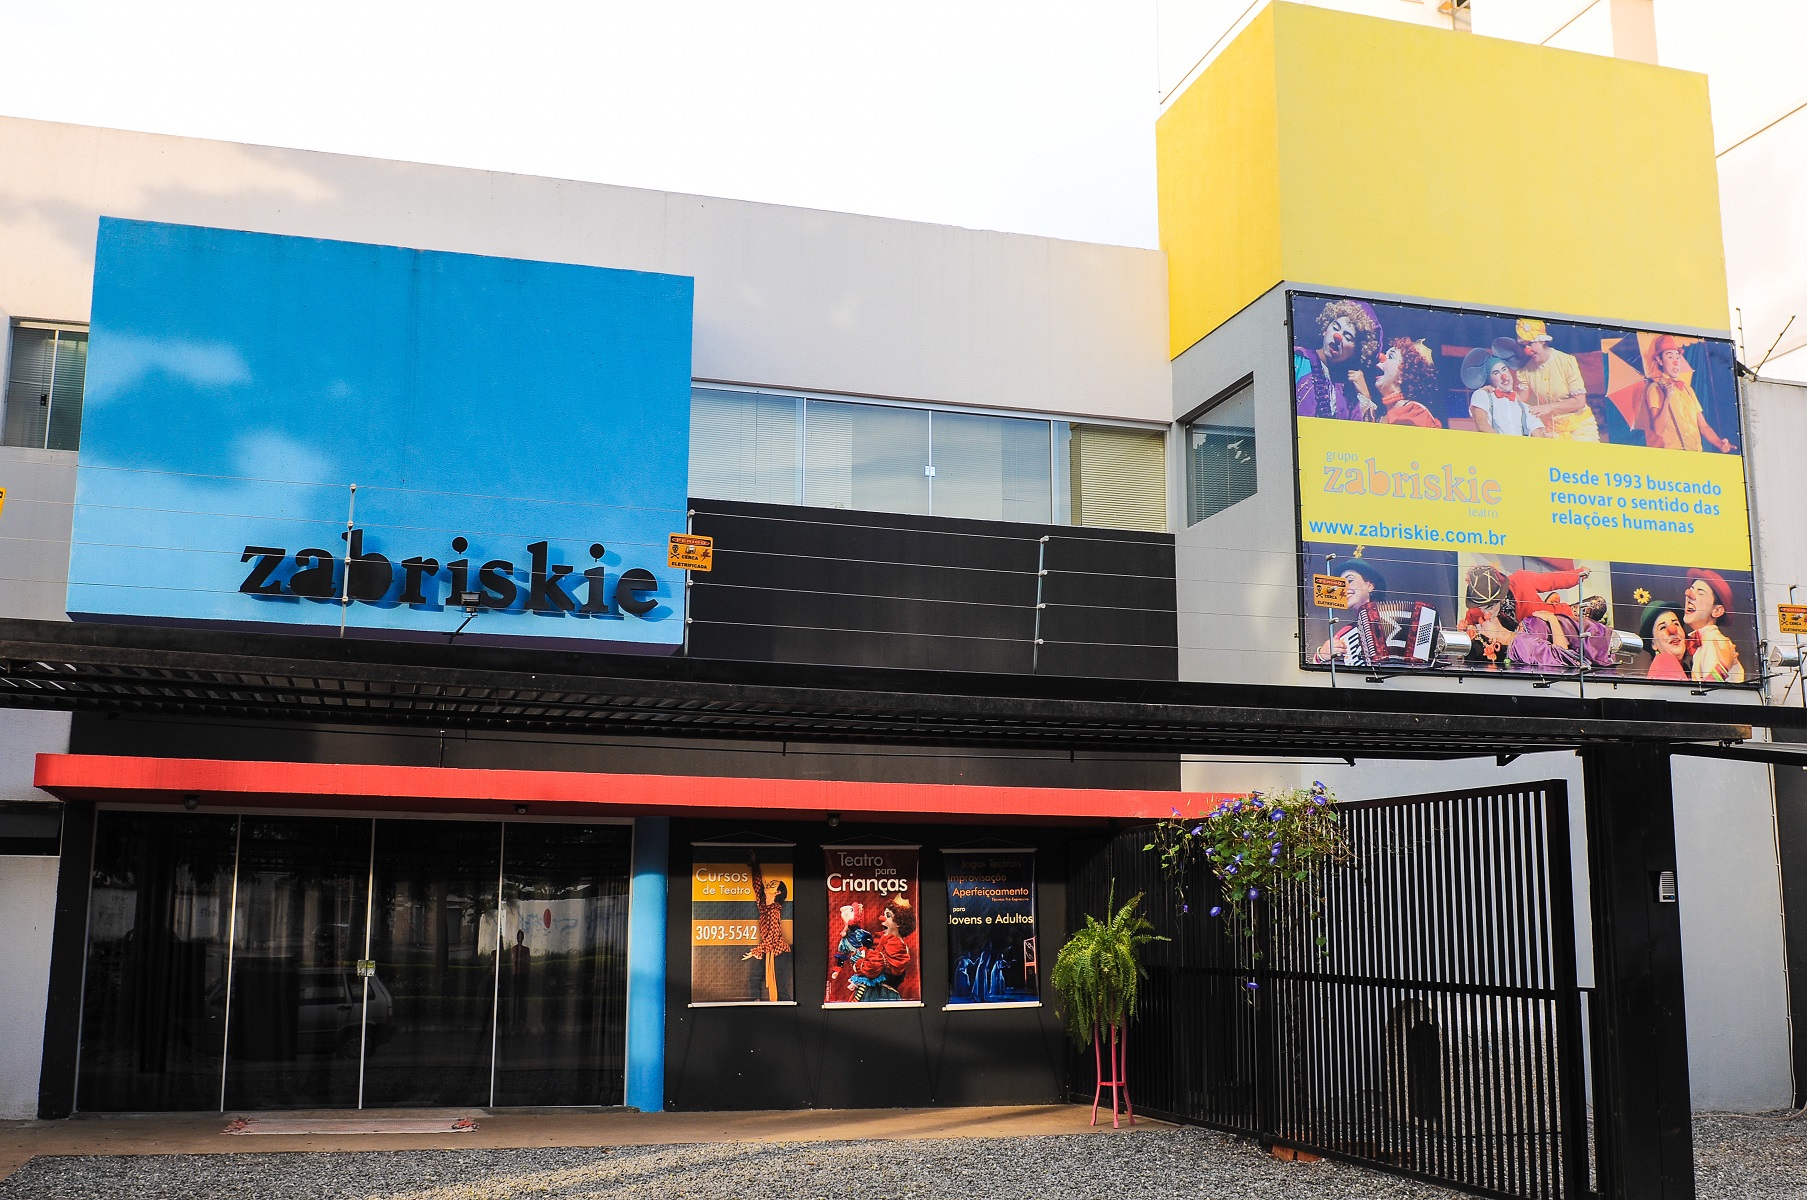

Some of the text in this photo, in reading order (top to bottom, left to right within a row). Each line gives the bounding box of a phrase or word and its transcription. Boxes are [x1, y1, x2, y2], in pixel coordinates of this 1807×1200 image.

[1326, 450, 1359, 463] grupo
[1323, 457, 1502, 505] zabriskie
[1549, 467, 1722, 496] Desde 1993 buscando
[1551, 491, 1720, 516] renovar o sentido das
[1468, 507, 1499, 518] teatro
[1552, 509, 1695, 534] relações humanas
[1309, 520, 1507, 546] www.zabriskie.com.br
[239, 528, 659, 617] zabriskie
[671, 561, 708, 569] ELETRIFICADA
[837, 852, 884, 867] Teatro
[695, 868, 748, 883] Cursos
[875, 868, 897, 877] para
[702, 884, 751, 895] de Teatro
[826, 873, 908, 896] Crianças
[952, 887, 1029, 898] Aperfeiçoamento
[948, 913, 1035, 925] Jovens e Adultos
[695, 925, 758, 941] 3093-5542
